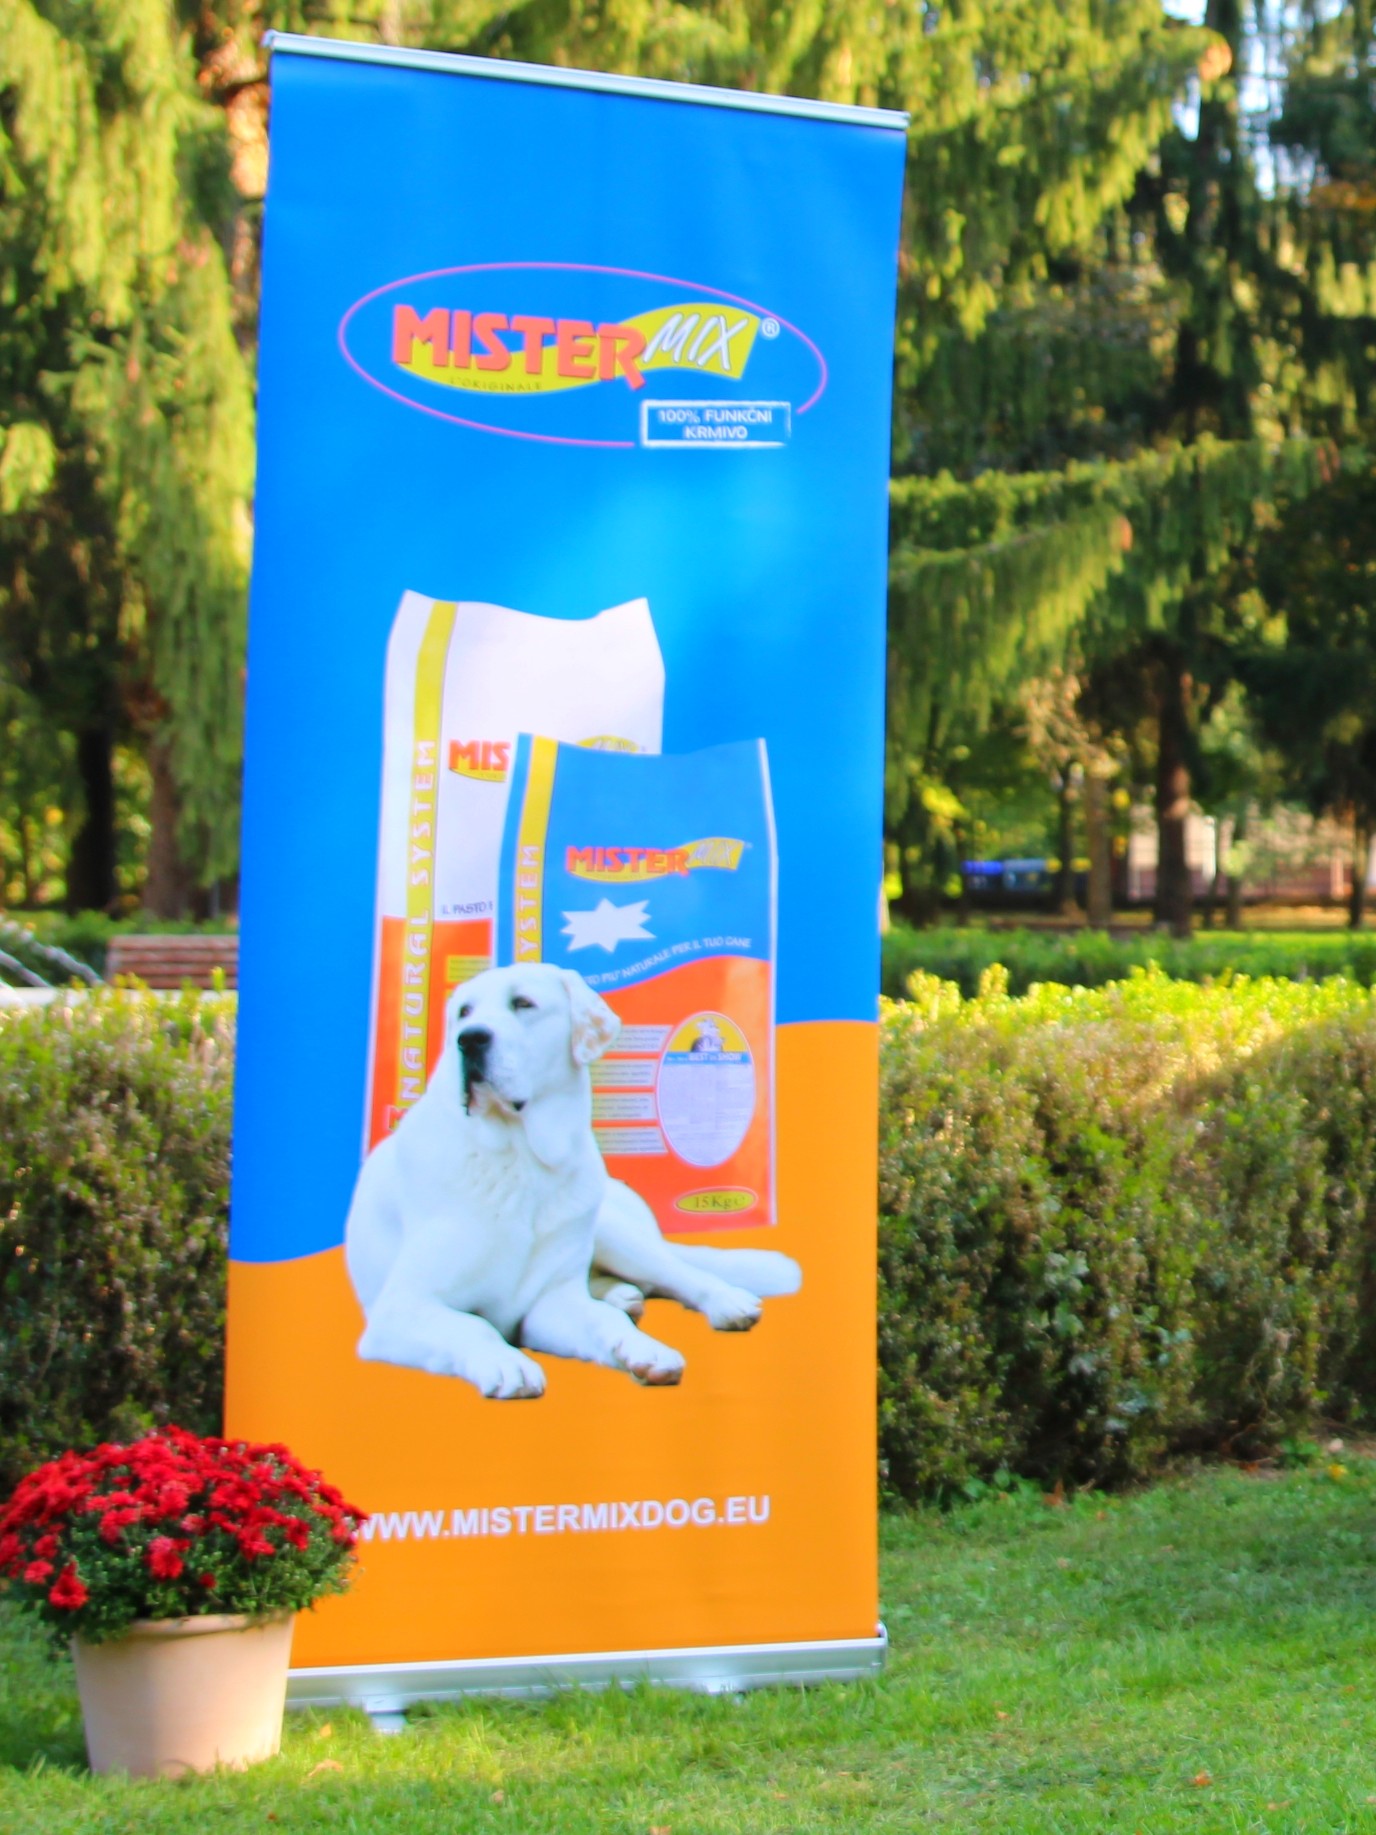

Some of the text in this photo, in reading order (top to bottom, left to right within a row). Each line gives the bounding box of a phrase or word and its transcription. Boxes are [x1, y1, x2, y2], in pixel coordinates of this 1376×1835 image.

[393, 304, 646, 391] MISTER
[642, 312, 748, 371] MIX
[659, 409, 700, 423] 100%
[685, 426, 747, 439] KRMIVO
[448, 739, 511, 771] MIS
[566, 845, 690, 877] MISTER
[400, 740, 435, 1100] NATURAL SYSTEM
[453, 901, 488, 914] PASTO
[519, 845, 540, 963] YSTEM
[621, 948, 671, 978] NATURALE
[671, 942, 692, 955] PER
[703, 936, 724, 949] TUO
[725, 936, 752, 949] CANE
